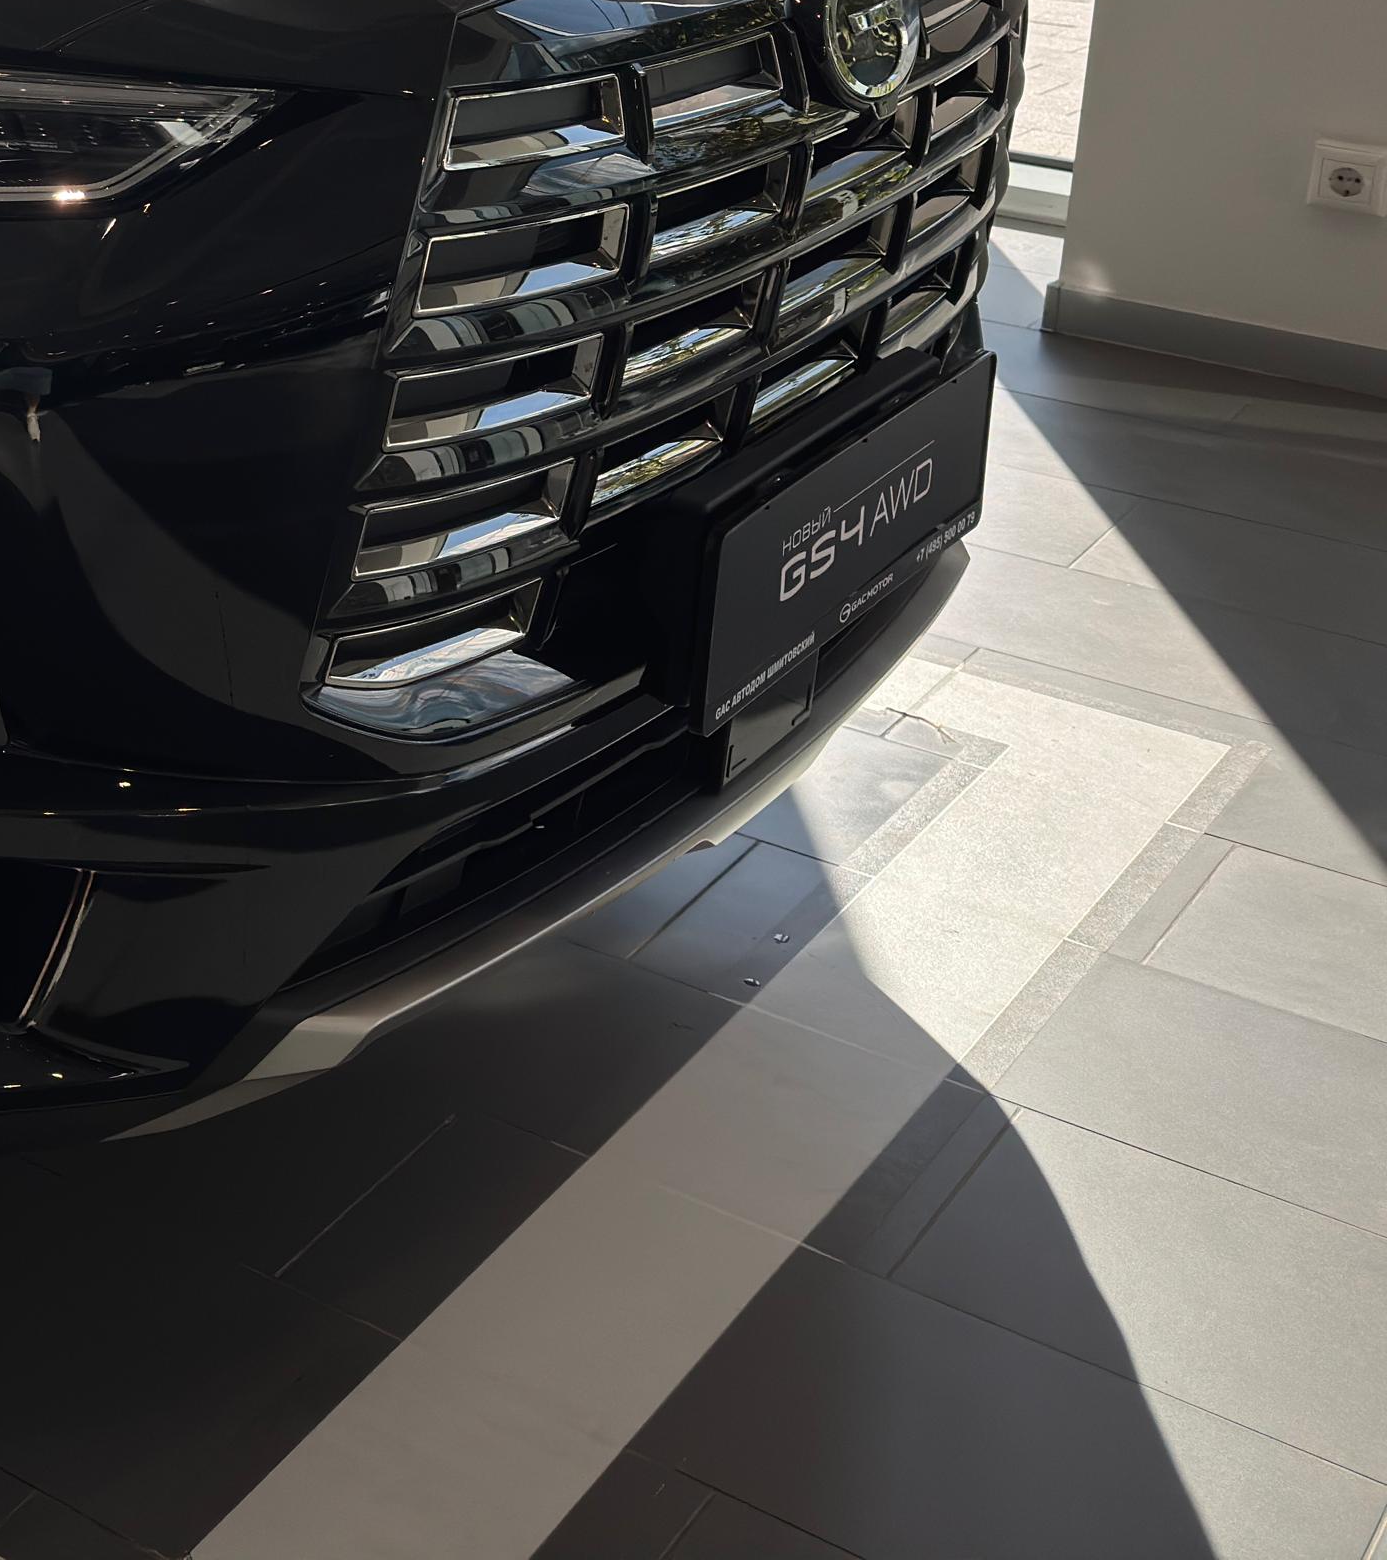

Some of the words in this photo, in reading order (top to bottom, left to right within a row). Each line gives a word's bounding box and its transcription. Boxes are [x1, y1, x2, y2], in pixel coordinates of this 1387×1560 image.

[779, 504, 866, 602] GS4
[869, 457, 933, 537] AWD
[782, 505, 831, 557] НОВЫЙ
[731, 670, 767, 708] АВТОДОМ
